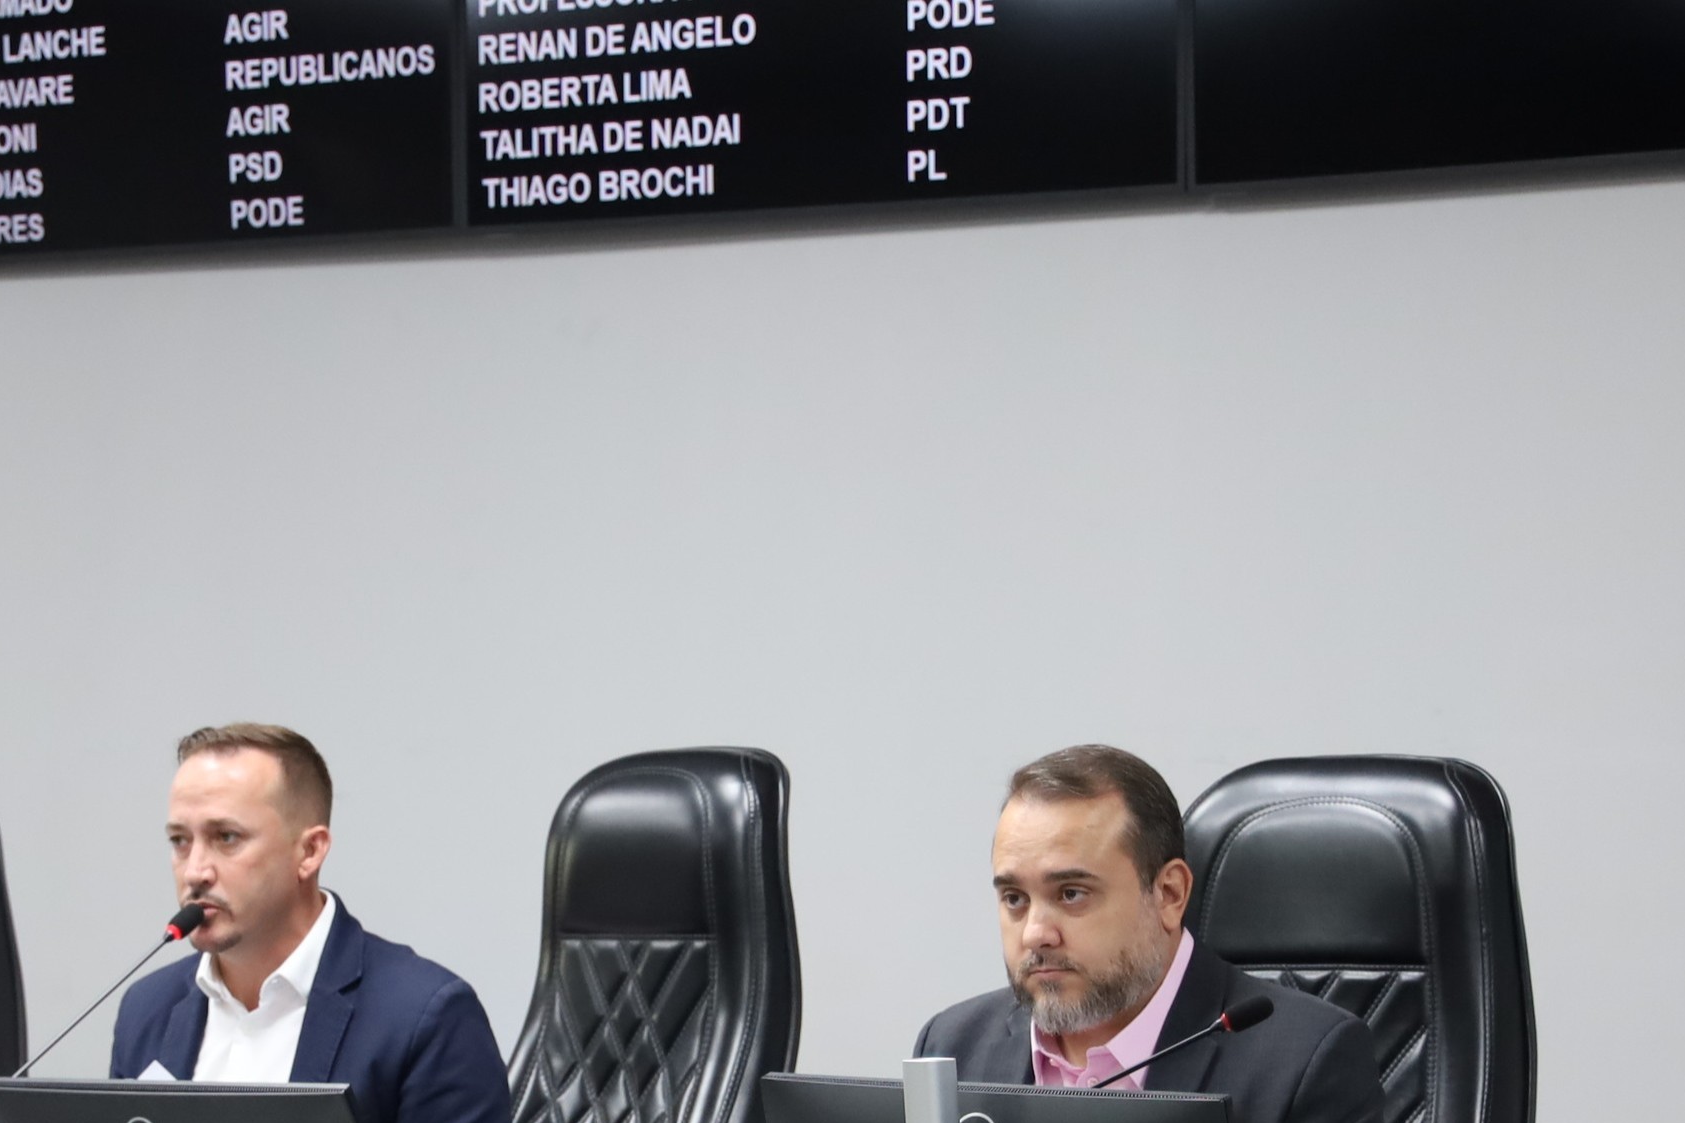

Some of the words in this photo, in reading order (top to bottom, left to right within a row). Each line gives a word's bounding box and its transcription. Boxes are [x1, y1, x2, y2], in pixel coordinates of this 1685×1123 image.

[224, 9, 289, 45] AGIR
[906, 0, 995, 32] PODE
[2, 26, 107, 63] LANCHE
[478, 27, 578, 65] RENAN
[585, 23, 626, 57] DE
[631, 13, 757, 54] ANGELO
[225, 44, 435, 91] REPUBLICANOS
[906, 46, 973, 82] PRD
[478, 74, 617, 114] ROBERTA
[622, 68, 692, 103] LIMA
[226, 103, 291, 138] AGIR
[906, 96, 971, 132] PDT
[480, 123, 598, 161] TALITHA
[602, 120, 643, 153] DE
[650, 113, 741, 150] NADAI
[228, 150, 283, 184] PSD
[907, 149, 947, 182] PL
[481, 172, 591, 208] THIAGO
[598, 164, 715, 202] BROCHI
[230, 195, 305, 230] PODE
